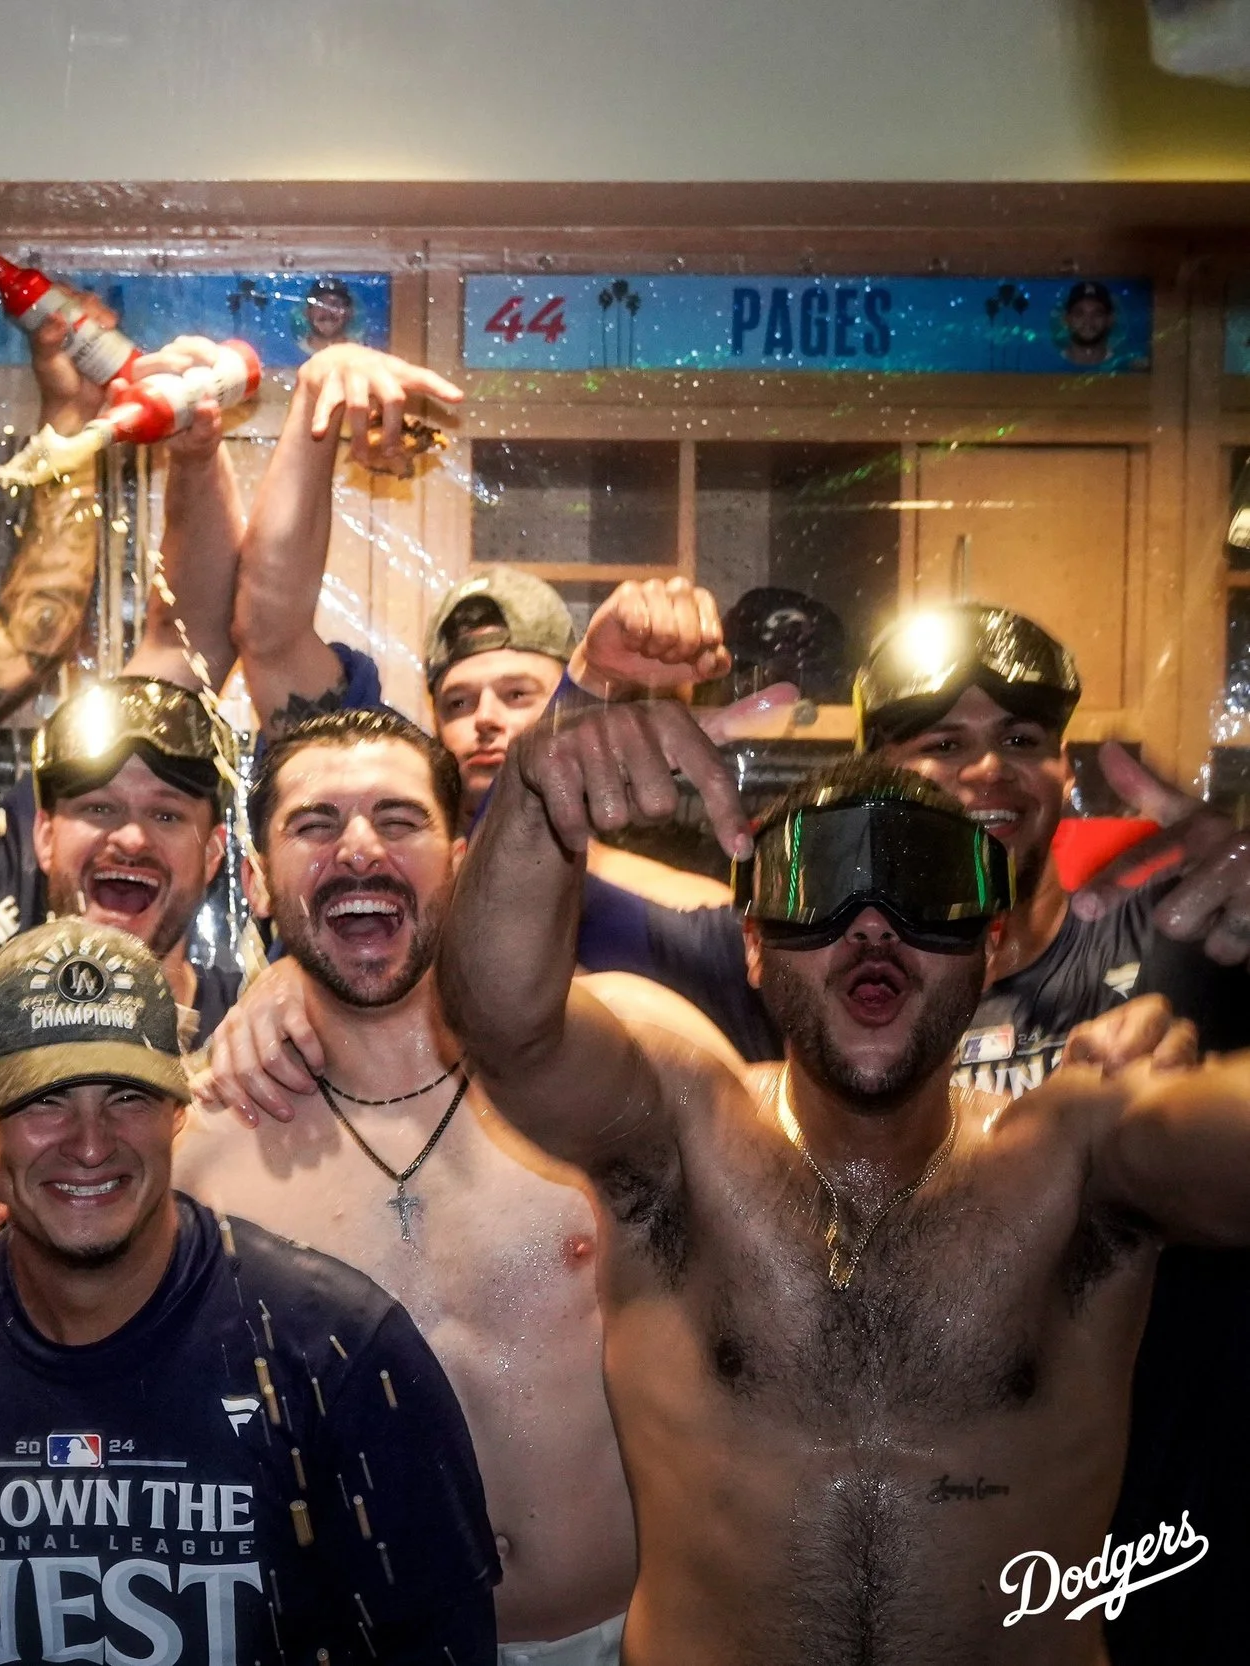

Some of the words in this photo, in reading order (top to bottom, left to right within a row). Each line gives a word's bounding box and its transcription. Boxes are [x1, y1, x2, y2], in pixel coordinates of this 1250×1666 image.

[485, 296, 567, 343] 44
[729, 288, 892, 357] PAGES
[31, 1002, 138, 1030] CHAMPIONS
[15, 1441, 41, 1455] 20
[108, 1439, 135, 1453] 24
[0, 1479, 132, 1528] OWN
[141, 1480, 255, 1532] THE
[109, 1535, 252, 1556] LEAGUE
